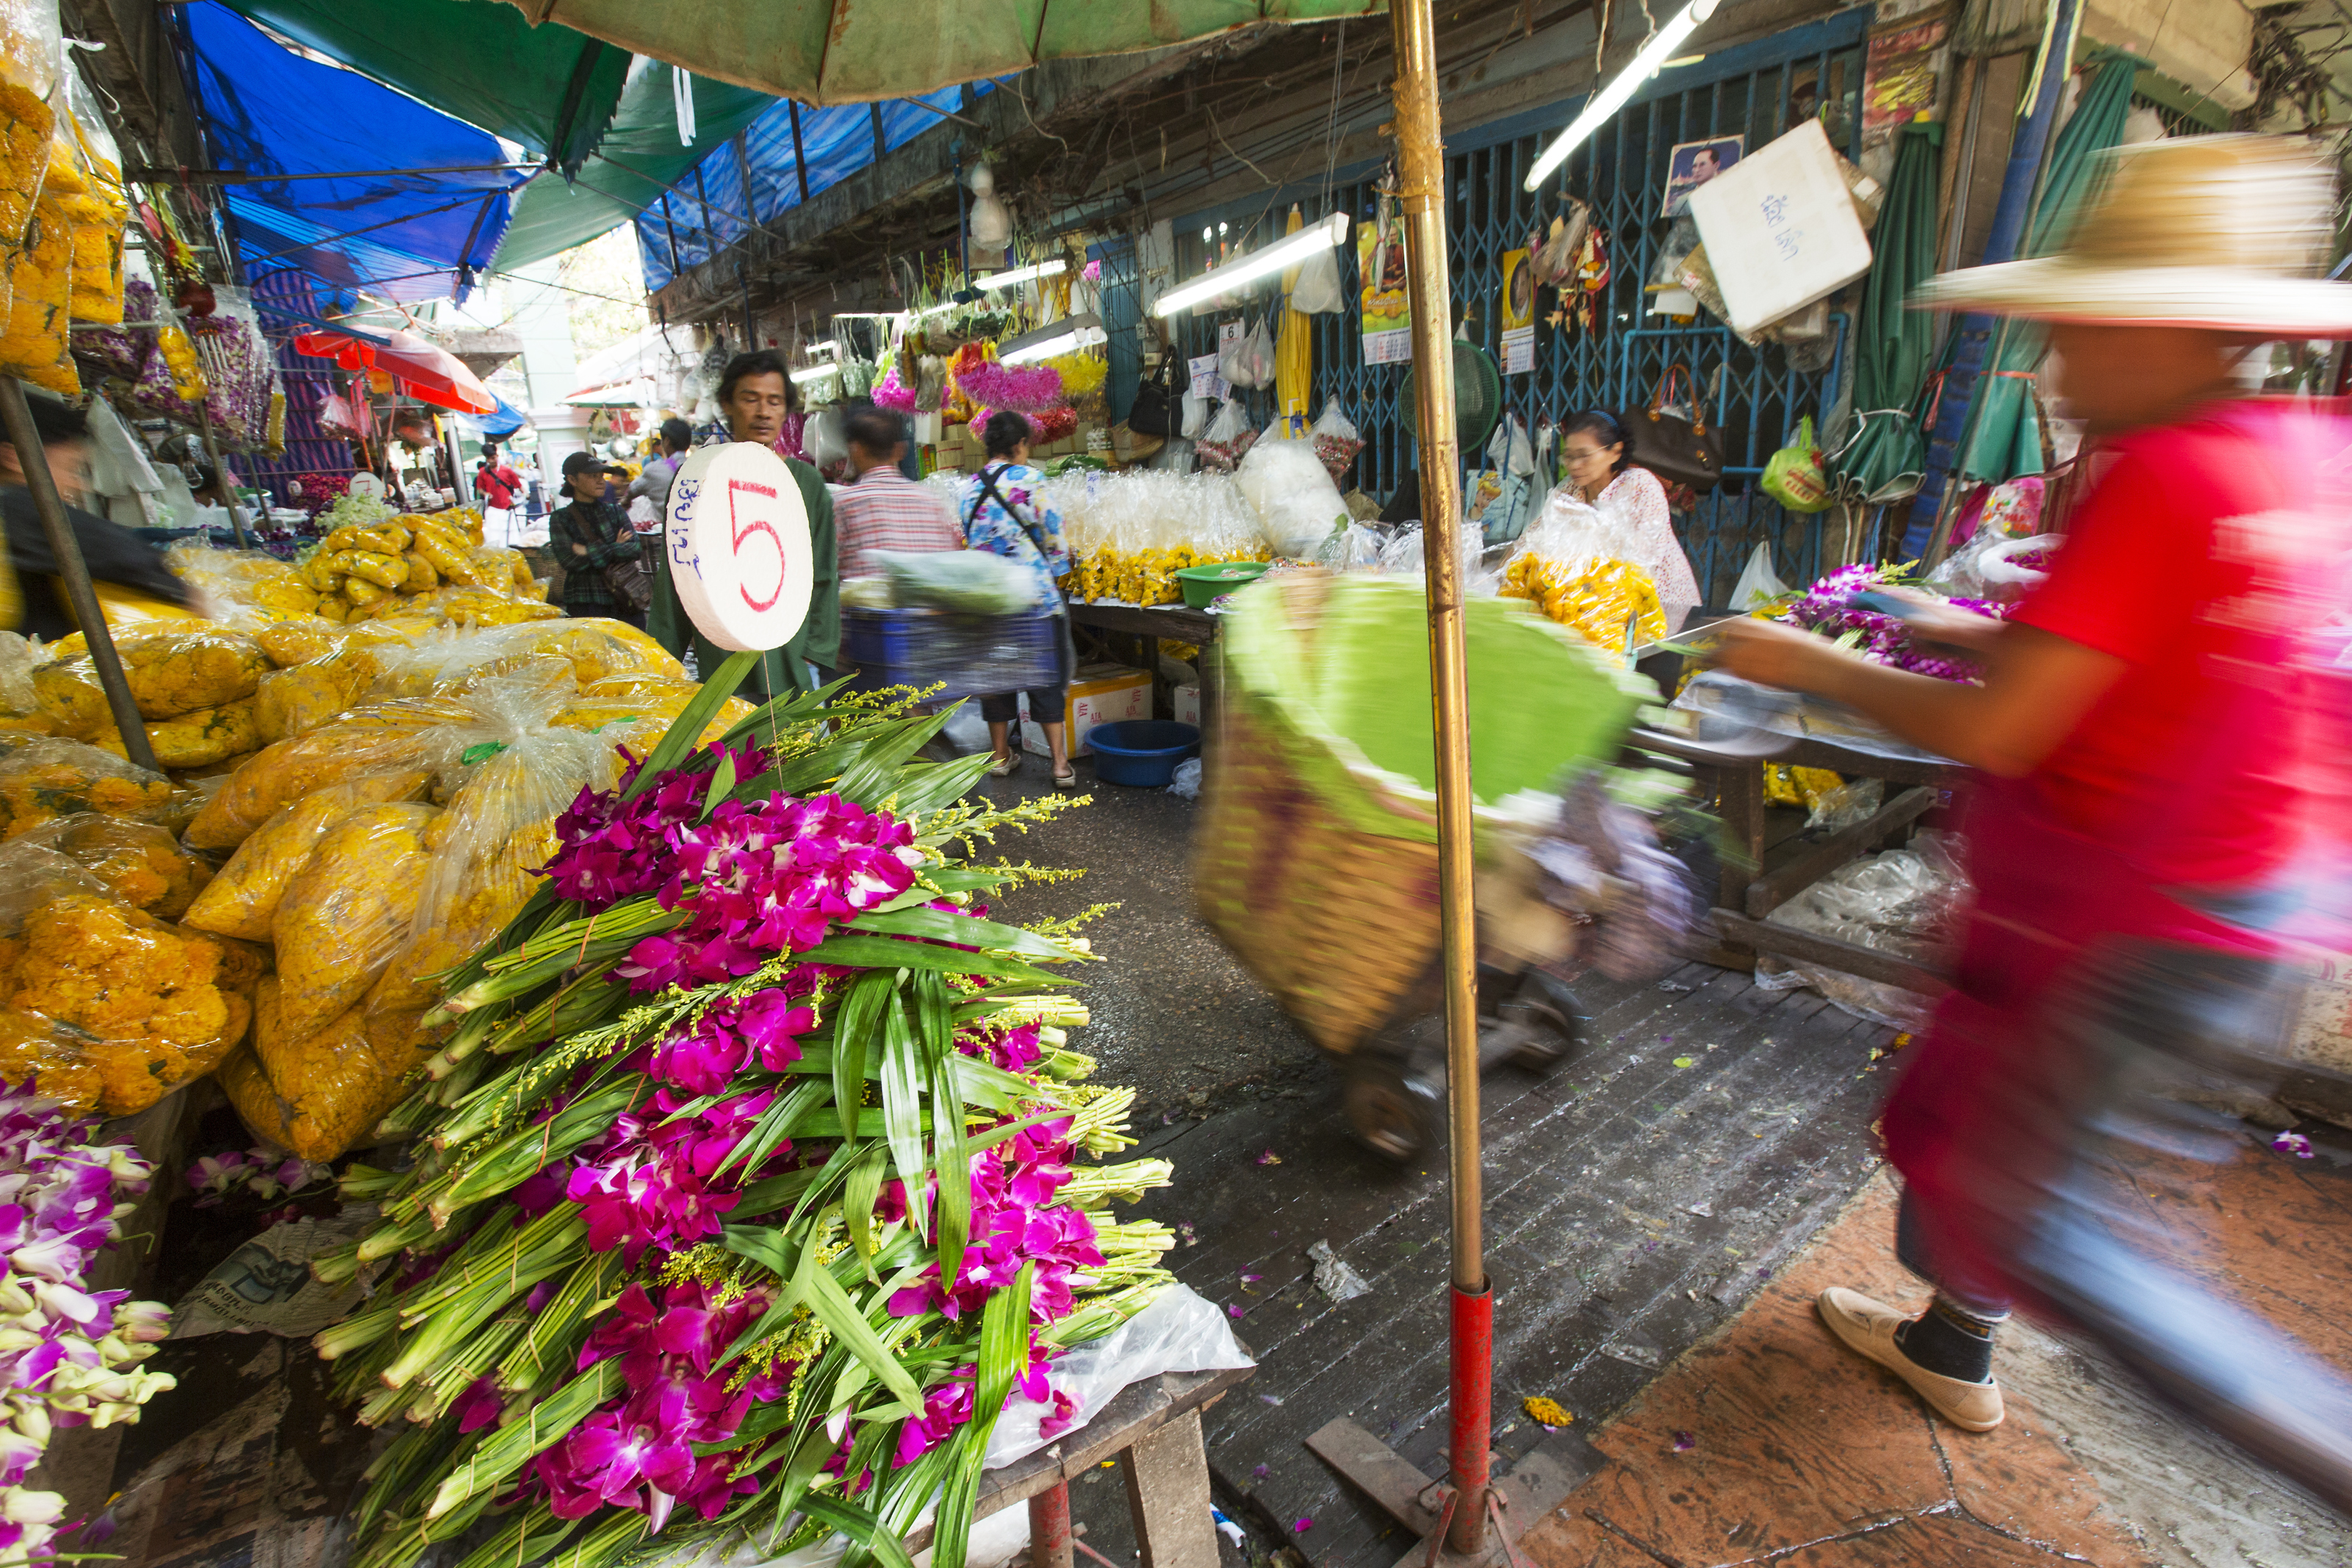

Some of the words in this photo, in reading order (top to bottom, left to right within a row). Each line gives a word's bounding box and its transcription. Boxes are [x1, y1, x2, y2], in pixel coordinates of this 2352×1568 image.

[1228, 326, 1234, 338] 6
[355, 480, 373, 496] 7
[728, 478, 785, 612] 5
[1090, 711, 1102, 722] AIA
